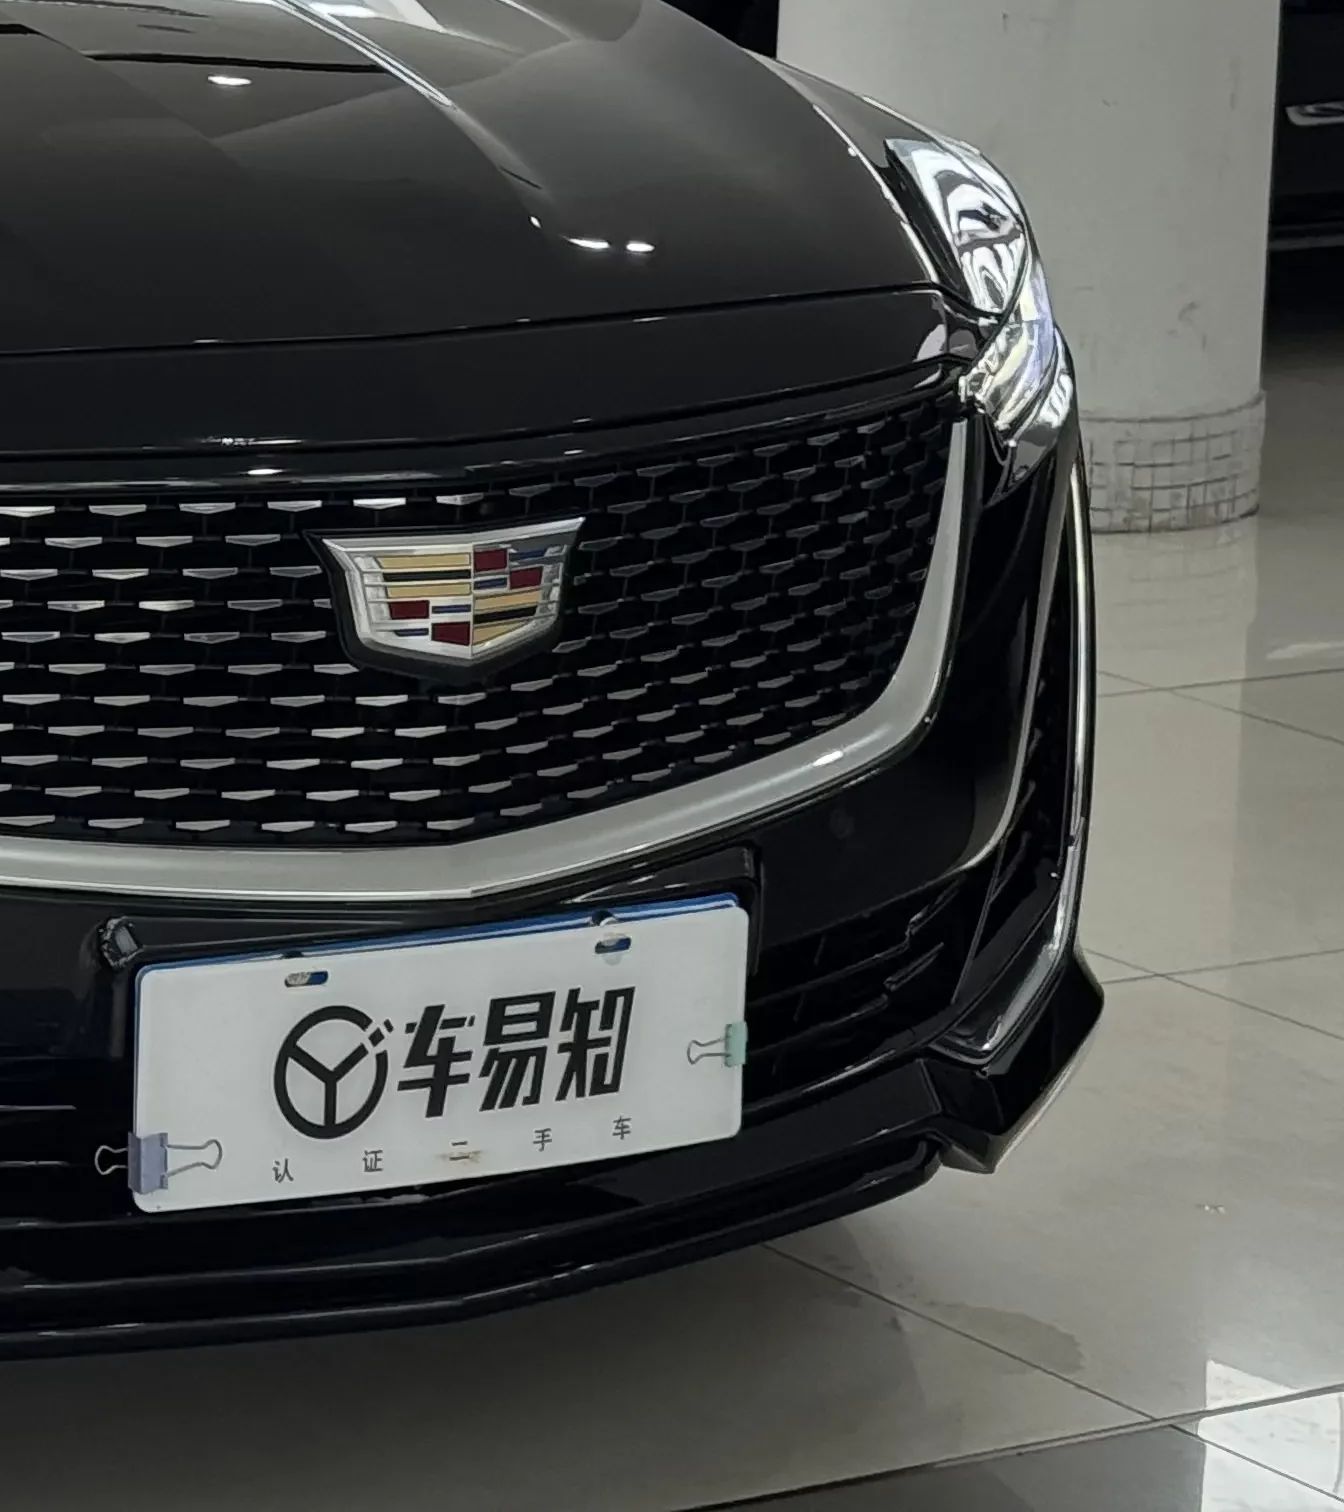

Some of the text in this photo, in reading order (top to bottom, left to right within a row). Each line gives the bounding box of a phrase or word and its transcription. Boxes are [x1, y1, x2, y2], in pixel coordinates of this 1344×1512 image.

[395, 985, 637, 1120] 车易知
[271, 1114, 632, 1184] 认证二手车
